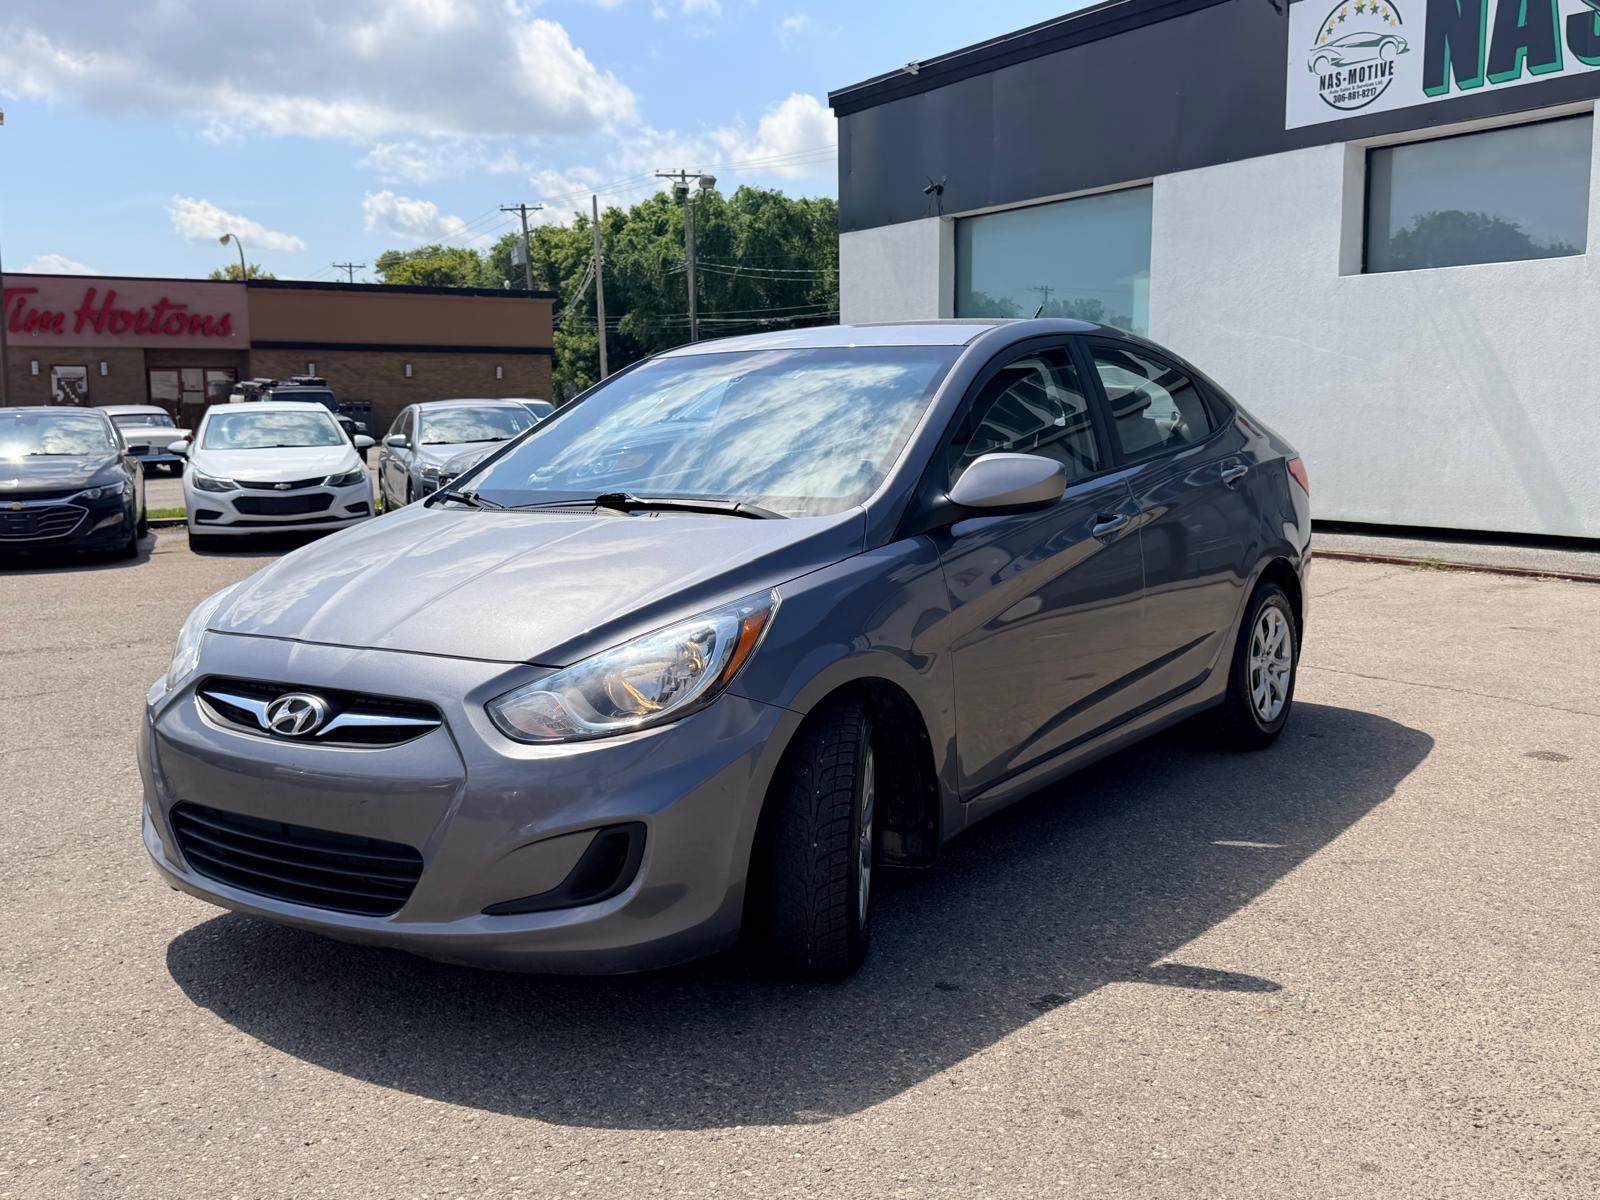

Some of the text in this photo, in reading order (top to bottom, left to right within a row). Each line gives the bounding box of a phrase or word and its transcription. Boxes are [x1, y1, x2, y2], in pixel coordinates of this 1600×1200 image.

[1320, 60, 1394, 91] NAS-MOTIVE
[1356, 82, 1375, 90] Services
[74, 287, 233, 337] Hortons
